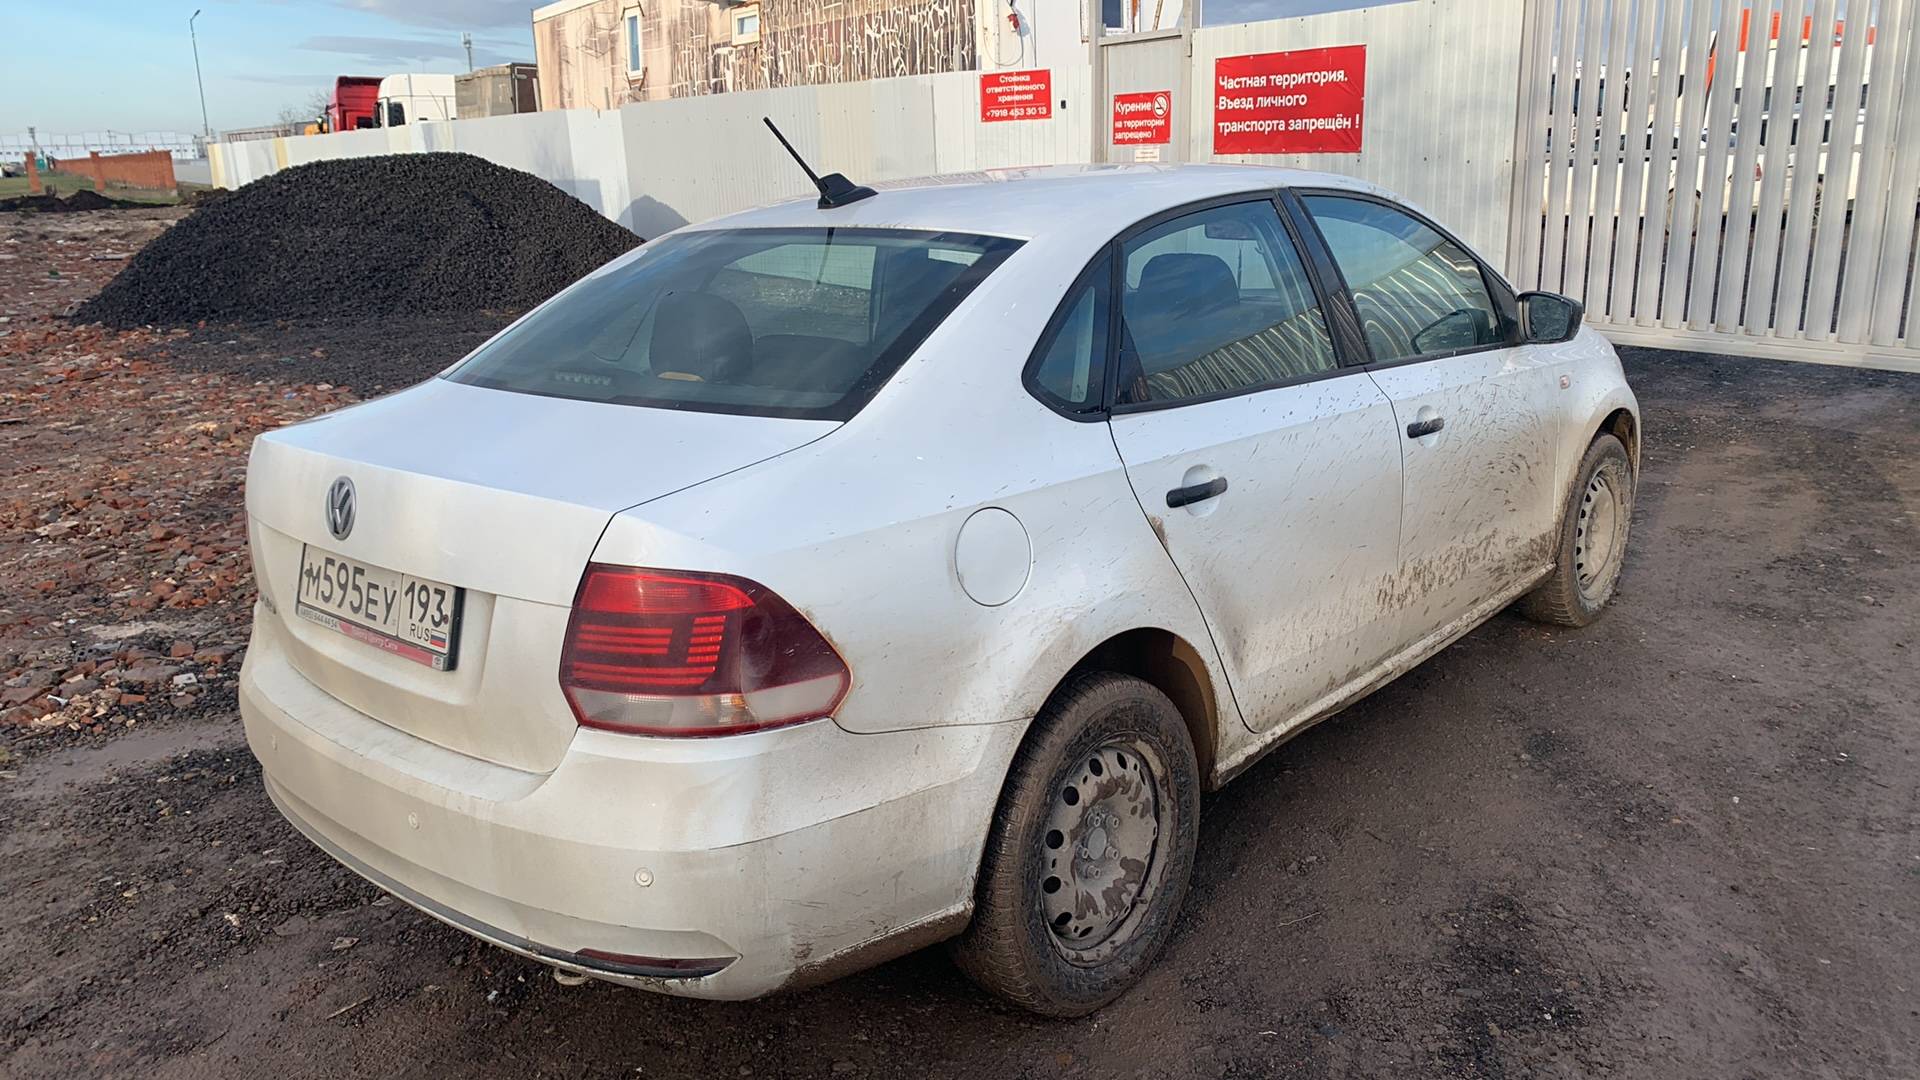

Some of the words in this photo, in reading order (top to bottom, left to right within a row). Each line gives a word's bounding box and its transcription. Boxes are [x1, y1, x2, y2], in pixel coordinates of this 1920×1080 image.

[999, 75, 1030, 83] Стоянка
[1219, 75, 1266, 90] Частная
[1269, 70, 1348, 89] территория.
[986, 83, 1046, 94] ответственного
[998, 94, 1034, 103] хранения
[1219, 96, 1253, 110] Въезд
[1256, 94, 1307, 108] личного
[1115, 101, 1152, 115] Курение
[1123, 119, 1165, 129] территории
[1218, 119, 1285, 136] транспорта
[1288, 113, 1351, 133] запрещён
[1115, 131, 1152, 141] запрещено
[404, 581, 447, 628] 193
[409, 623, 430, 642] RUS
